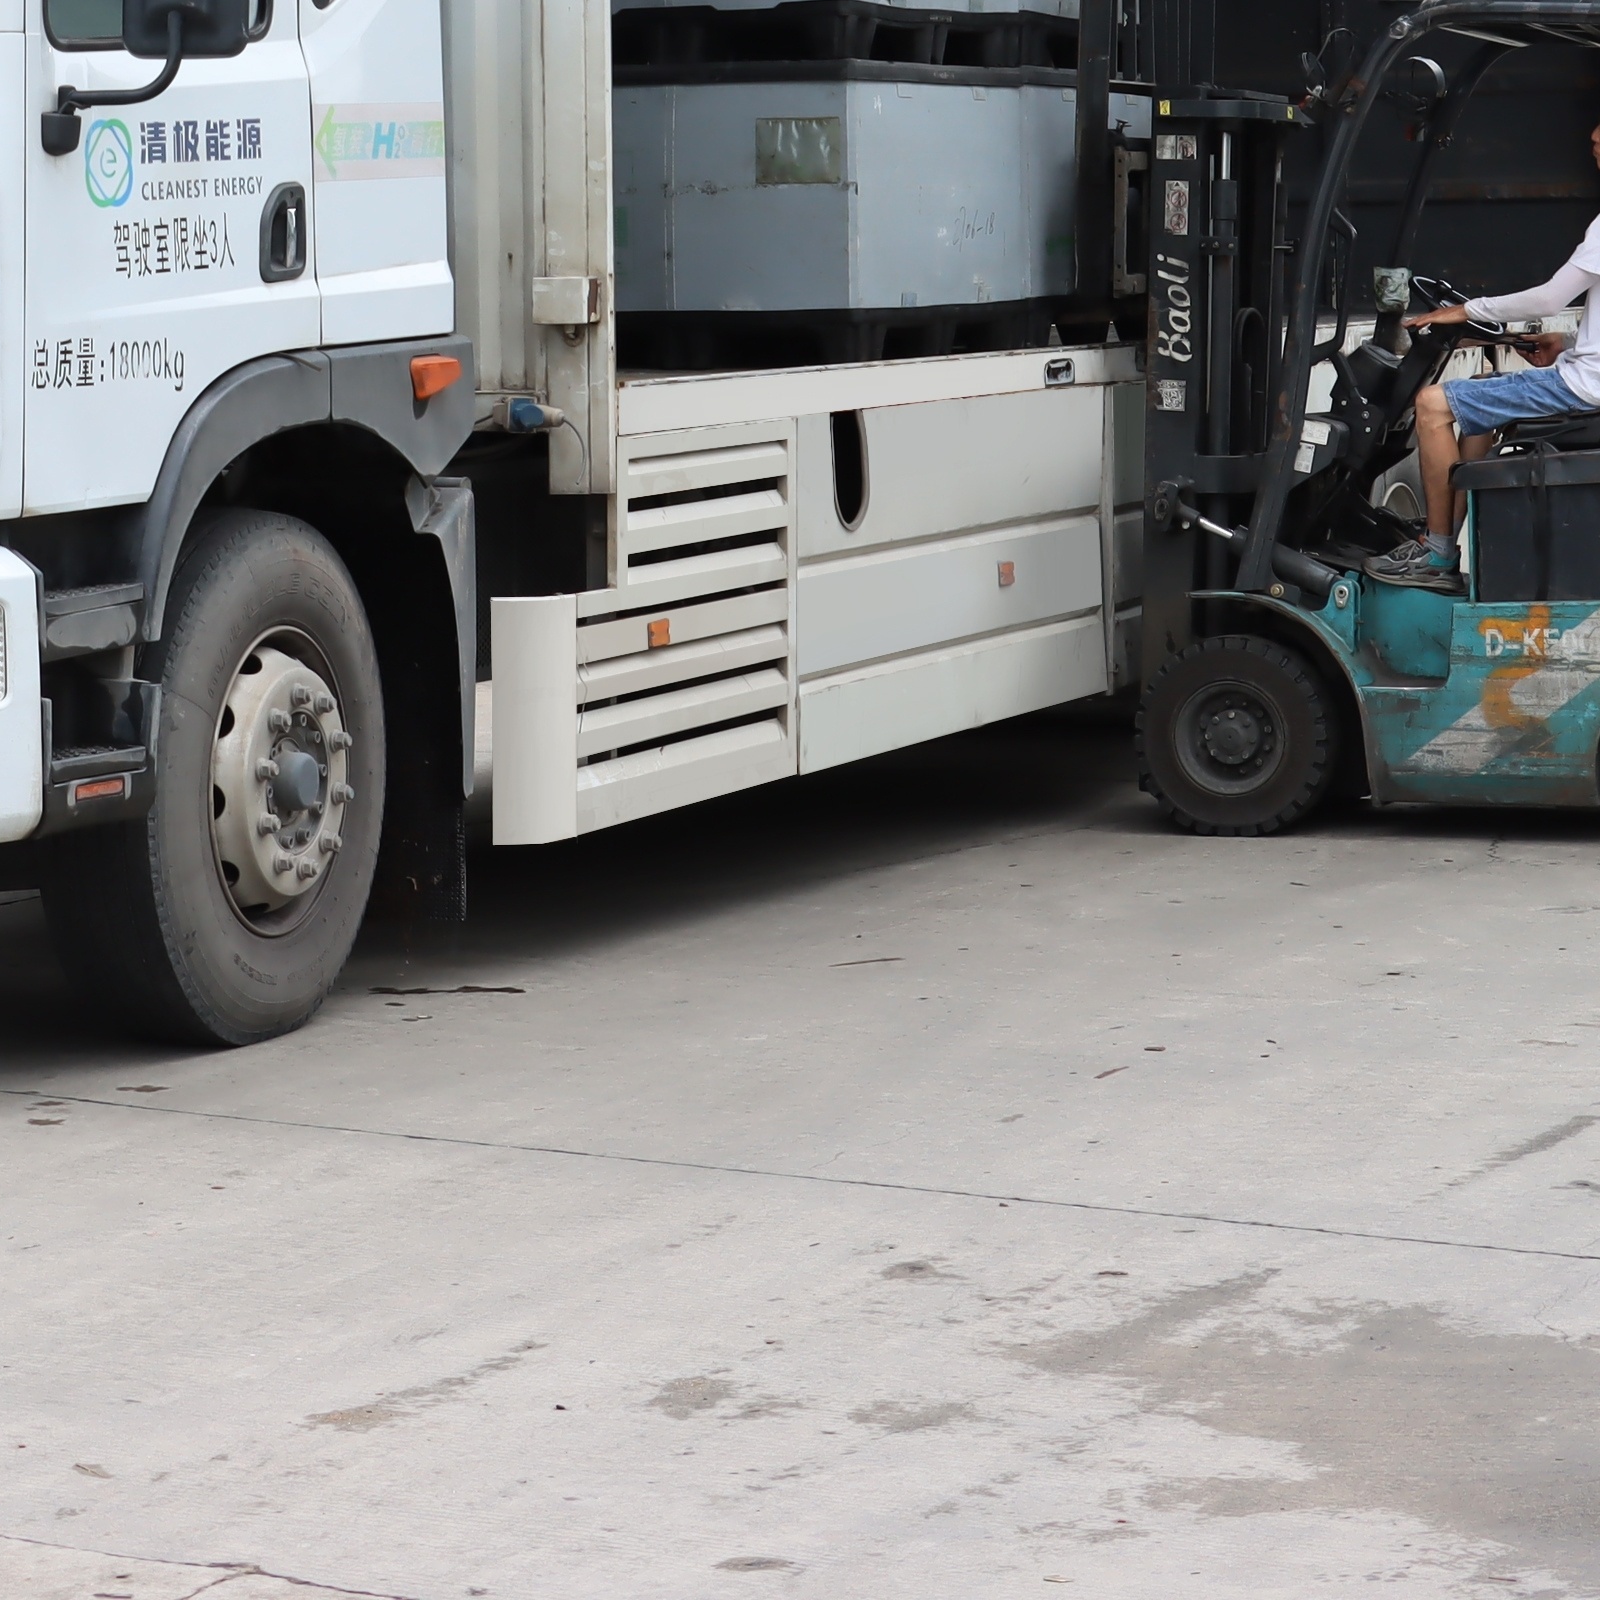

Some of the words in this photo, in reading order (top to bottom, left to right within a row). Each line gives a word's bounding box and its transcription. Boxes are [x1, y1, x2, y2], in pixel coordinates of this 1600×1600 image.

[139, 118, 262, 164] 清极能源
[141, 179, 207, 201] CLEANEST
[214, 176, 263, 197] ENERGY
[113, 211, 235, 279] 驾驶室限坐3人
[1157, 253, 1193, 362] Baoli
